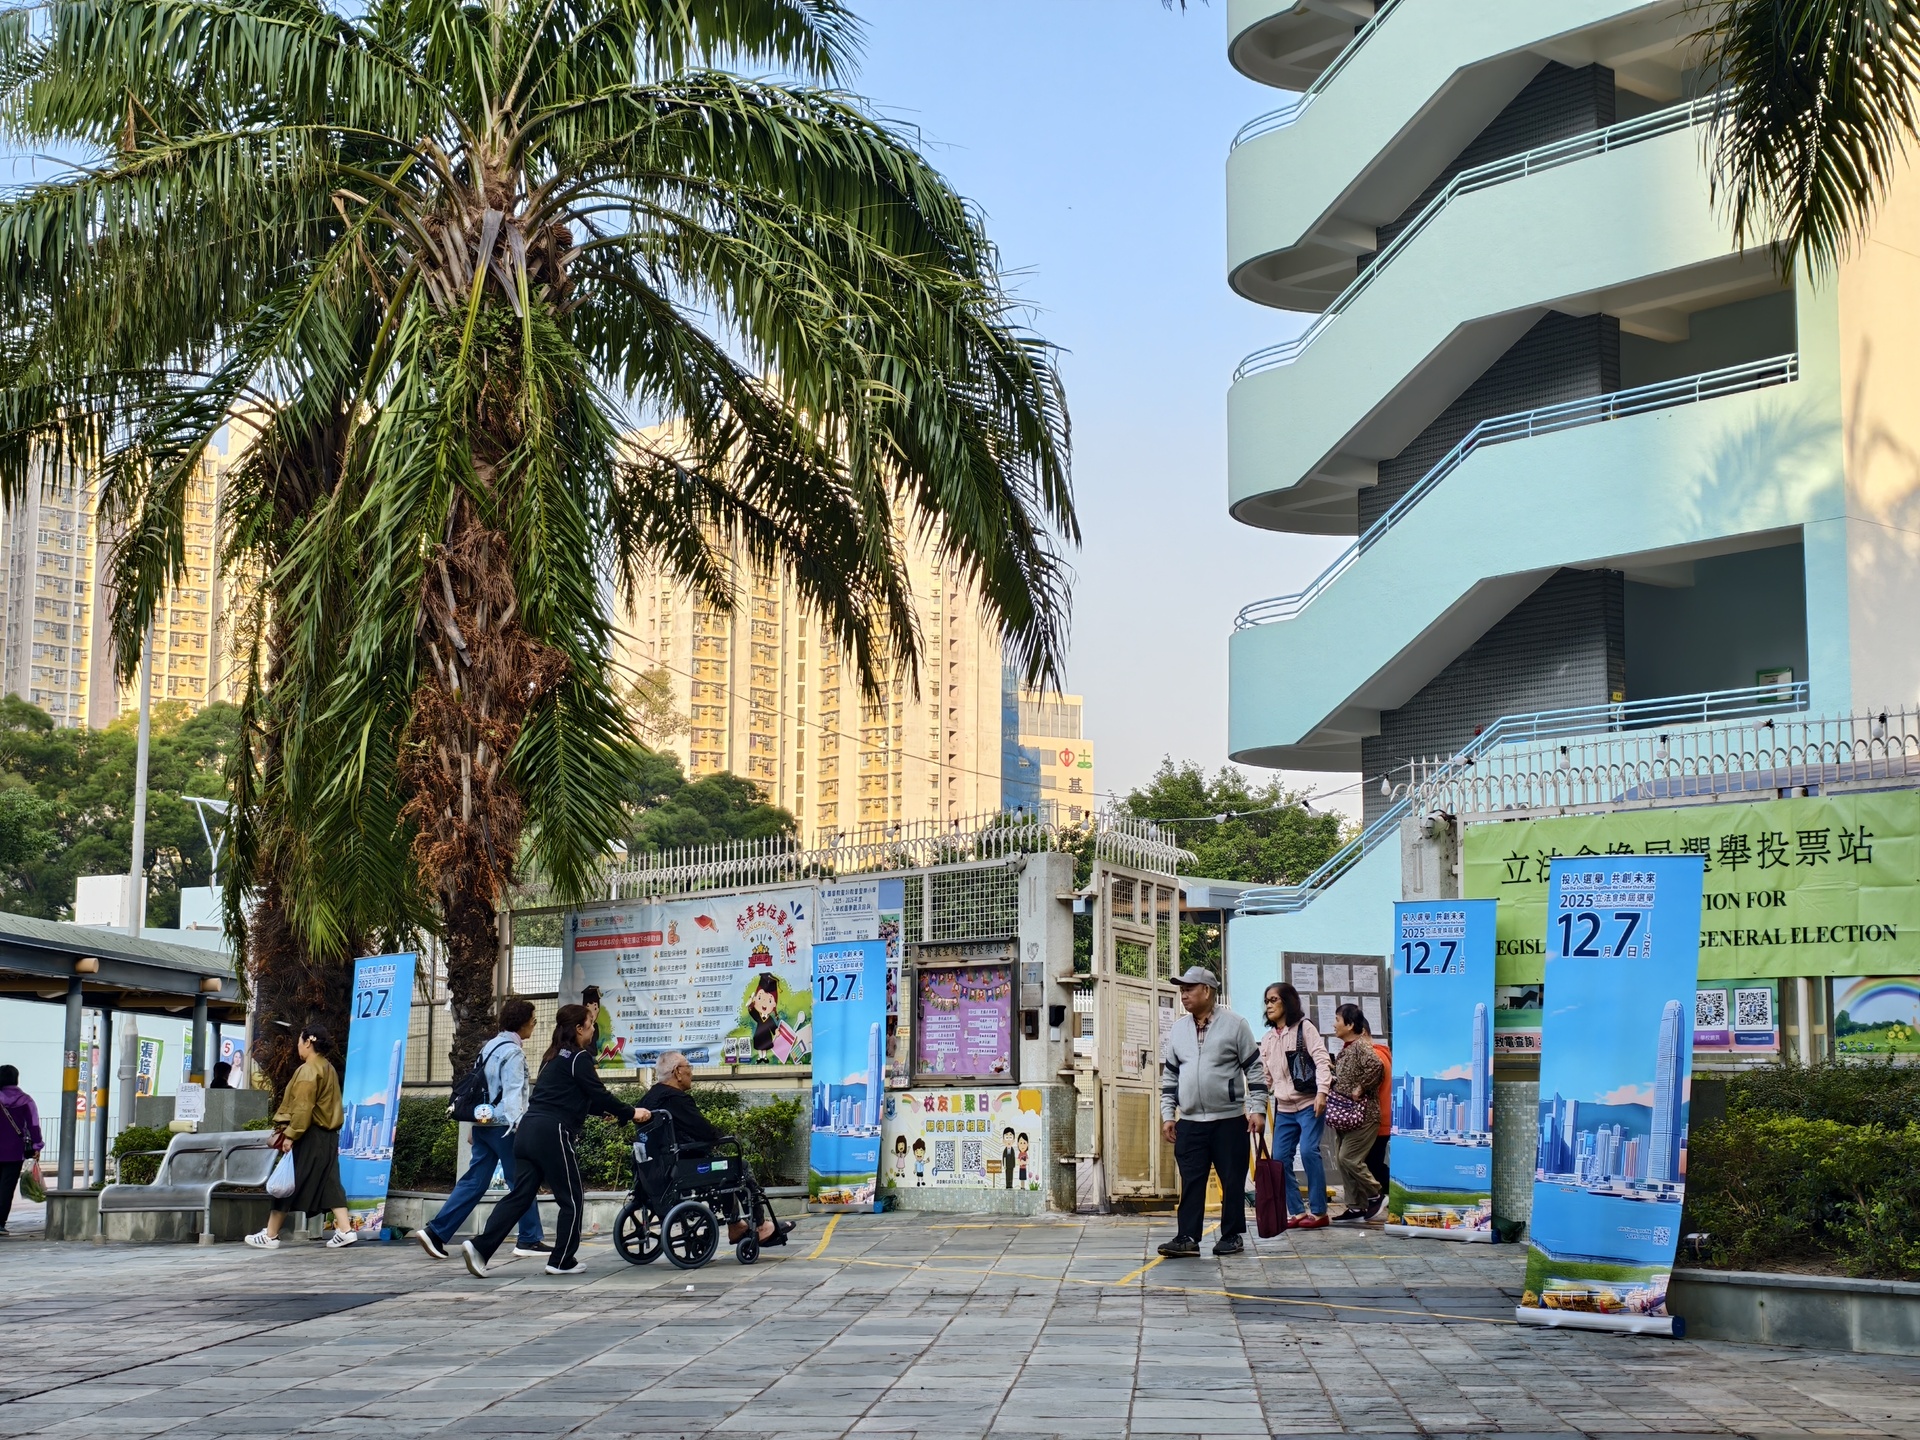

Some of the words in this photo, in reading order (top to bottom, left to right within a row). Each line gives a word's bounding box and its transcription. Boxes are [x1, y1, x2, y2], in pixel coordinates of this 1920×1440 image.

[1562, 873, 1604, 885] 投入選舉
[1612, 872, 1656, 884] 共創未來
[1560, 894, 1594, 908] 2025
[1746, 890, 1787, 909] FOR
[1402, 928, 1425, 938] 2025
[1791, 924, 1898, 944] ELECTION
[818, 964, 835, 974] 2025
[223, 1042, 231, 1054] 5
